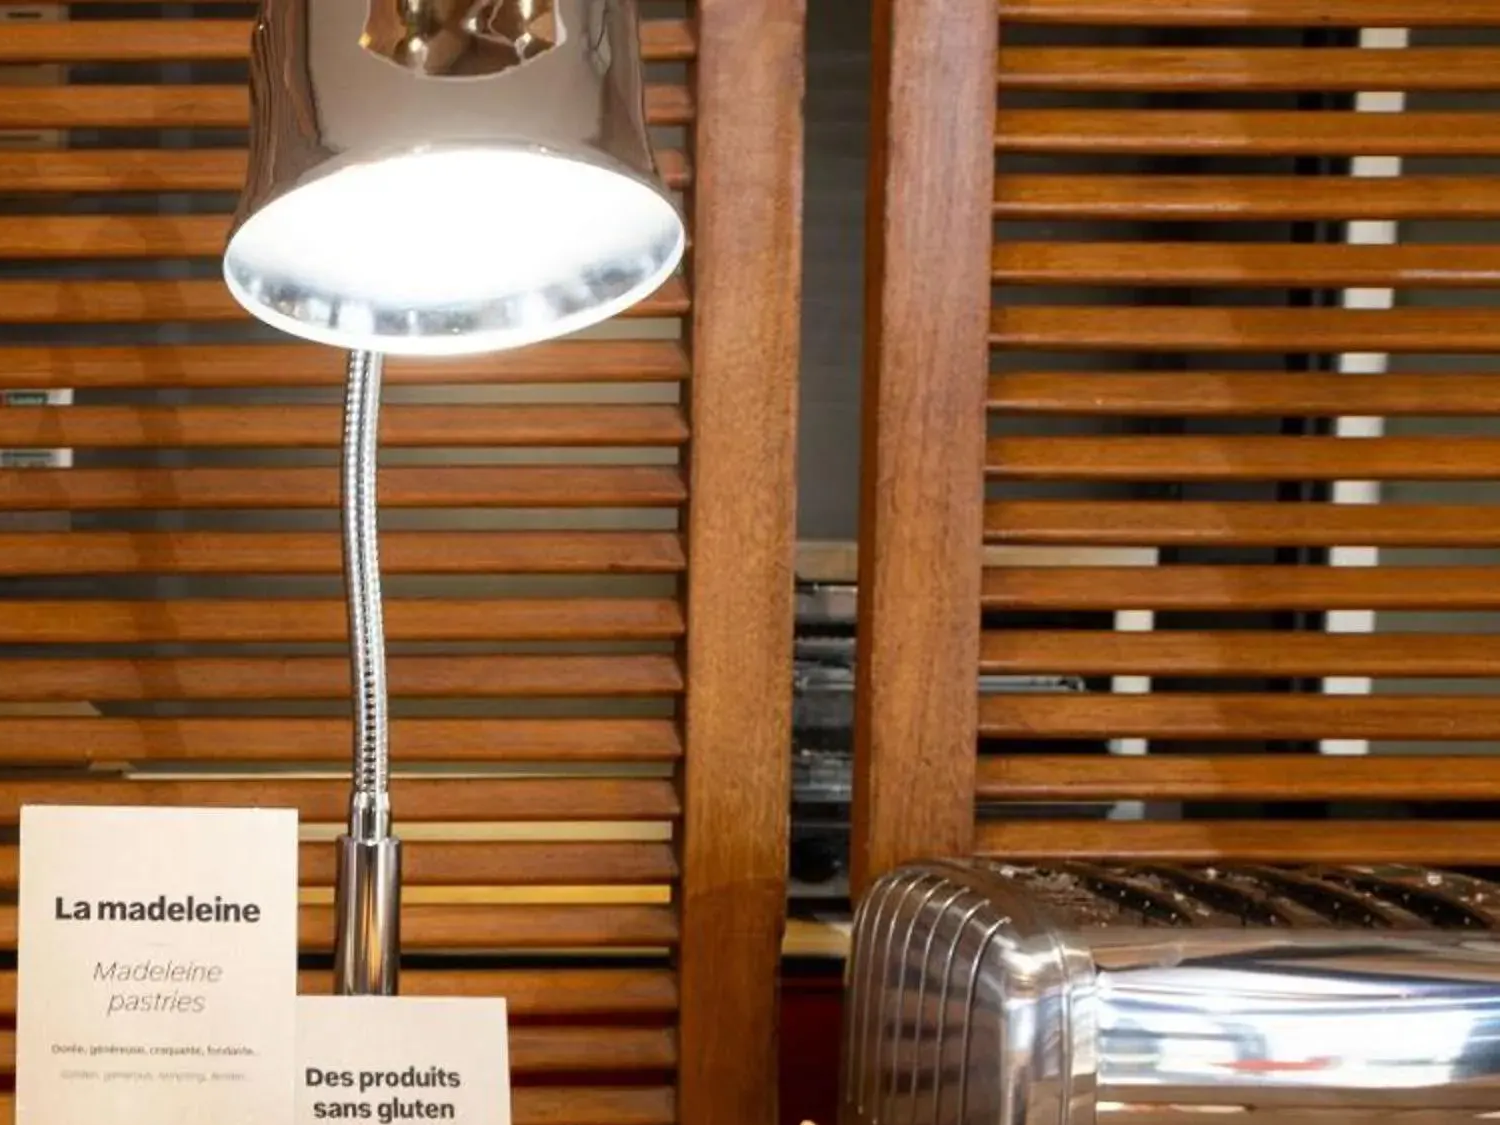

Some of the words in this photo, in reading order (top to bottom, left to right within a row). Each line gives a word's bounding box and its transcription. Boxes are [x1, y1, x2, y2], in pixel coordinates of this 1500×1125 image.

[54, 896, 91, 921] La
[97, 894, 261, 922] madeleine
[92, 959, 224, 983] Madeleine
[106, 988, 207, 1017] pastries
[305, 1067, 354, 1087] Des
[359, 1065, 461, 1093] produits
[313, 1100, 372, 1119] sans
[376, 1096, 456, 1125] gluten
